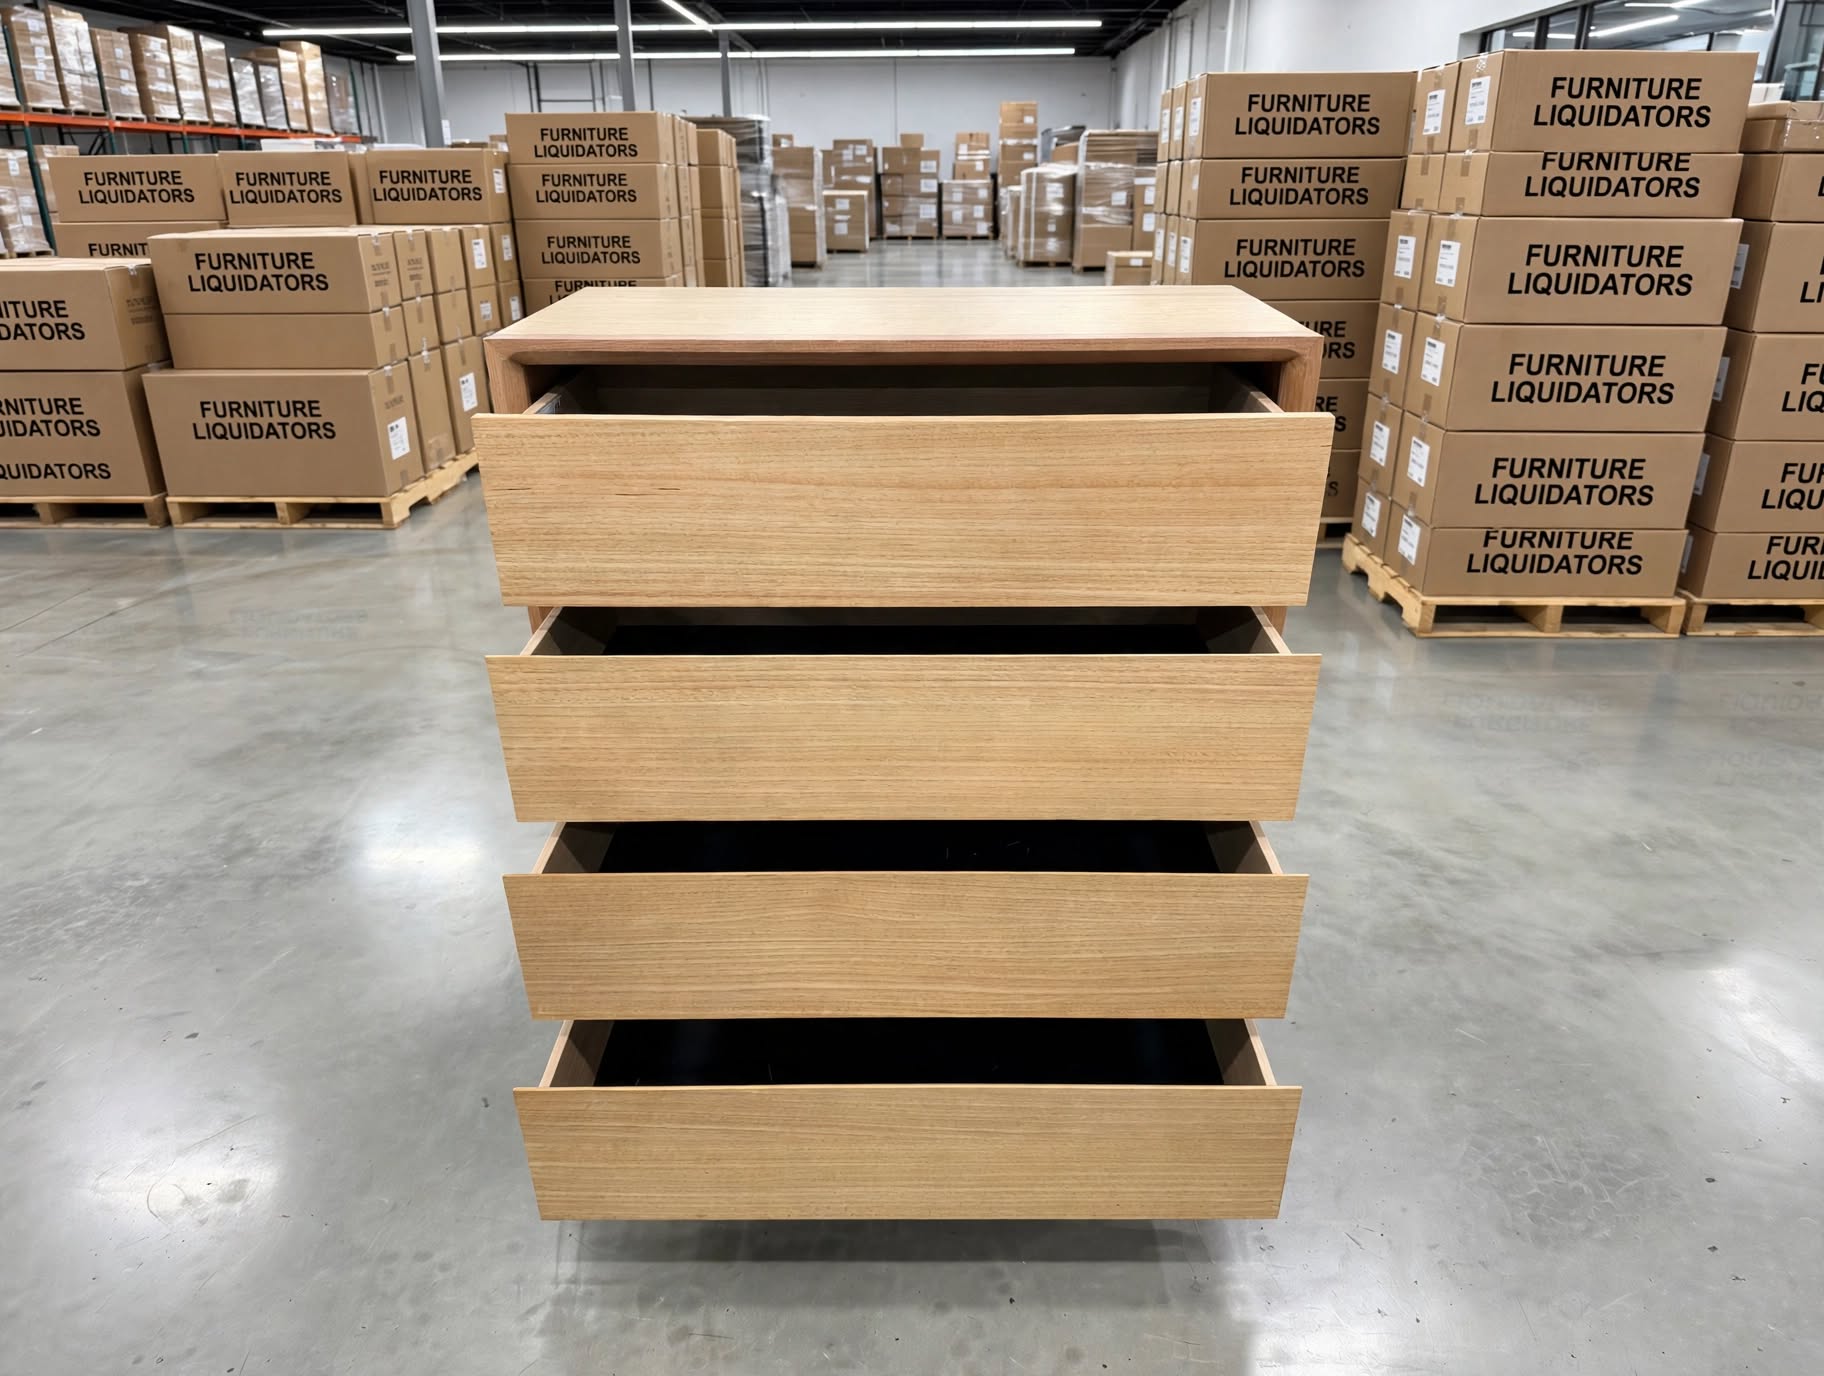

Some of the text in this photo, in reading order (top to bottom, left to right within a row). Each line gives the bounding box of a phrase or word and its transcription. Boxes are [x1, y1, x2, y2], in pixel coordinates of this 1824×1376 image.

[1550, 76, 1702, 100] FURNITURE
[1247, 93, 1371, 113] FURNITURE
[1235, 116, 1380, 136] LIQUIDATORS
[1533, 104, 1711, 128] LIQUIDATORS
[540, 127, 629, 142] FURNITURE
[534, 143, 638, 158] LIQUIDATORS
[1541, 151, 1692, 172] FURNITURE
[83, 170, 183, 186] FURNITURE
[235, 171, 332, 187] FURNITURE
[379, 169, 473, 185] FURNITURE
[541, 173, 628, 187] FURNITURE
[1241, 166, 1360, 185] FURNITURE
[78, 188, 195, 205] LIQUIDATORS
[229, 188, 343, 205] LIQUIDATORS
[372, 186, 483, 202] LIQUIDATORS
[535, 189, 637, 204] LIQUIDATORS
[1229, 187, 1369, 206] LIQUIDATORS
[1524, 175, 1701, 198] LIQUIDATORS
[547, 235, 631, 249] FURNITURE
[1236, 238, 1357, 257] FURNITURE
[194, 251, 315, 271] FURNITURE
[541, 250, 641, 265] LIQUIDATORS
[1525, 244, 1684, 268] FURNITURE
[1224, 259, 1366, 279] LIQUIDATORS
[188, 273, 329, 293] LIQUIDATORS
[1507, 272, 1693, 297] LIQUIDATORS
[1509, 353, 1666, 377] FURNITURE
[1491, 380, 1675, 405] LIQUIDATORS
[199, 399, 322, 419] FURNITURE
[192, 421, 336, 441] LIQUIDATORS
[1492, 457, 1646, 480] FURNITURE
[1474, 483, 1654, 507] LIQUIDATORS
[1483, 530, 1634, 550] FURNITURE
[1466, 553, 1643, 576] LIQUIDATORS
